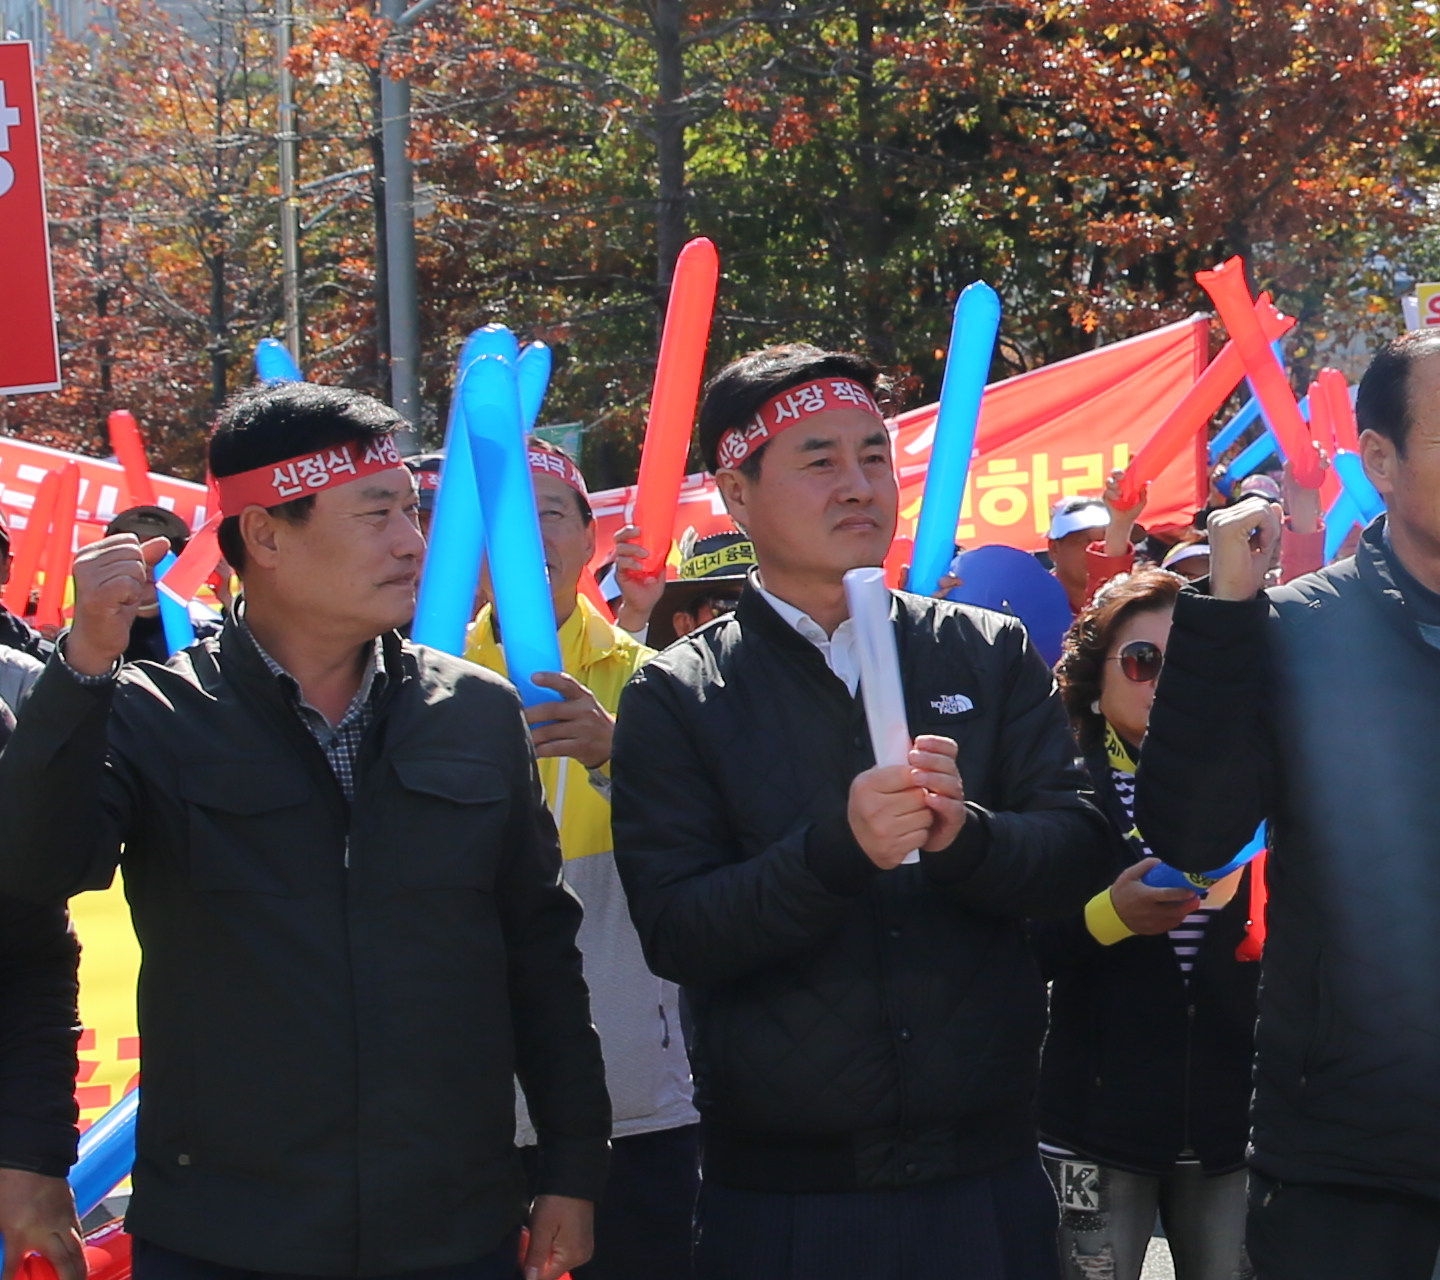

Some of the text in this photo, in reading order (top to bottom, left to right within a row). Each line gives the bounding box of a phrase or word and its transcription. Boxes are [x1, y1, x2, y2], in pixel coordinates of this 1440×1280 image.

[774, 384, 827, 424] 사장
[271, 446, 358, 498] 신정식
[528, 451, 567, 479] 적극
